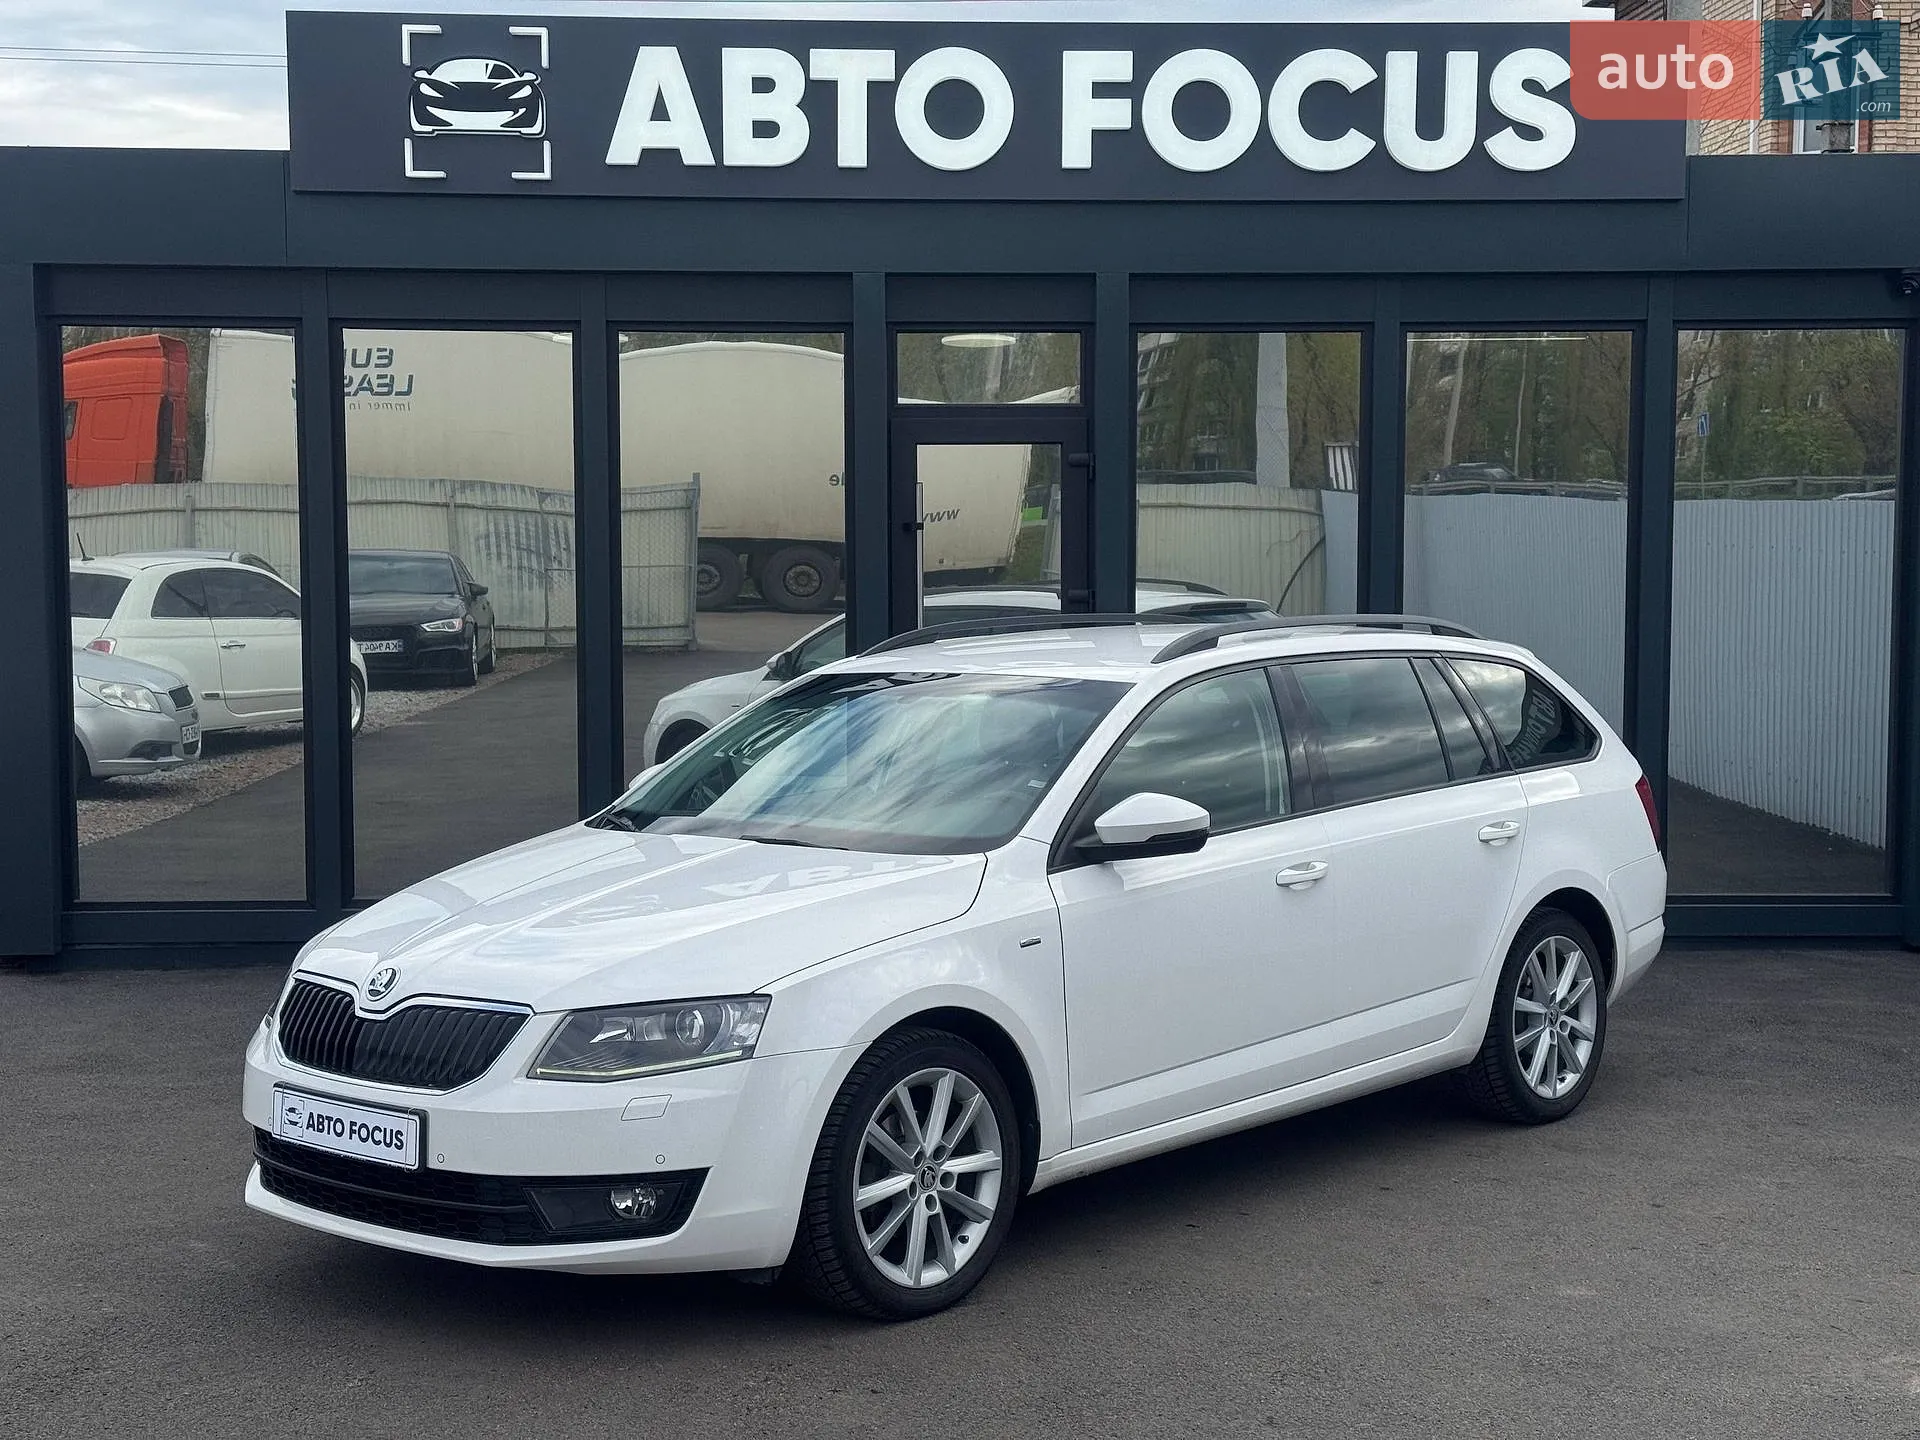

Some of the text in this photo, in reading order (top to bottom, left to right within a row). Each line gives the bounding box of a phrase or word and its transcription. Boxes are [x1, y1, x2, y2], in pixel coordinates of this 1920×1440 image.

[605, 45, 1577, 172] АВТО FOCUS
[306, 1111, 404, 1151] АВТО FOCUS
